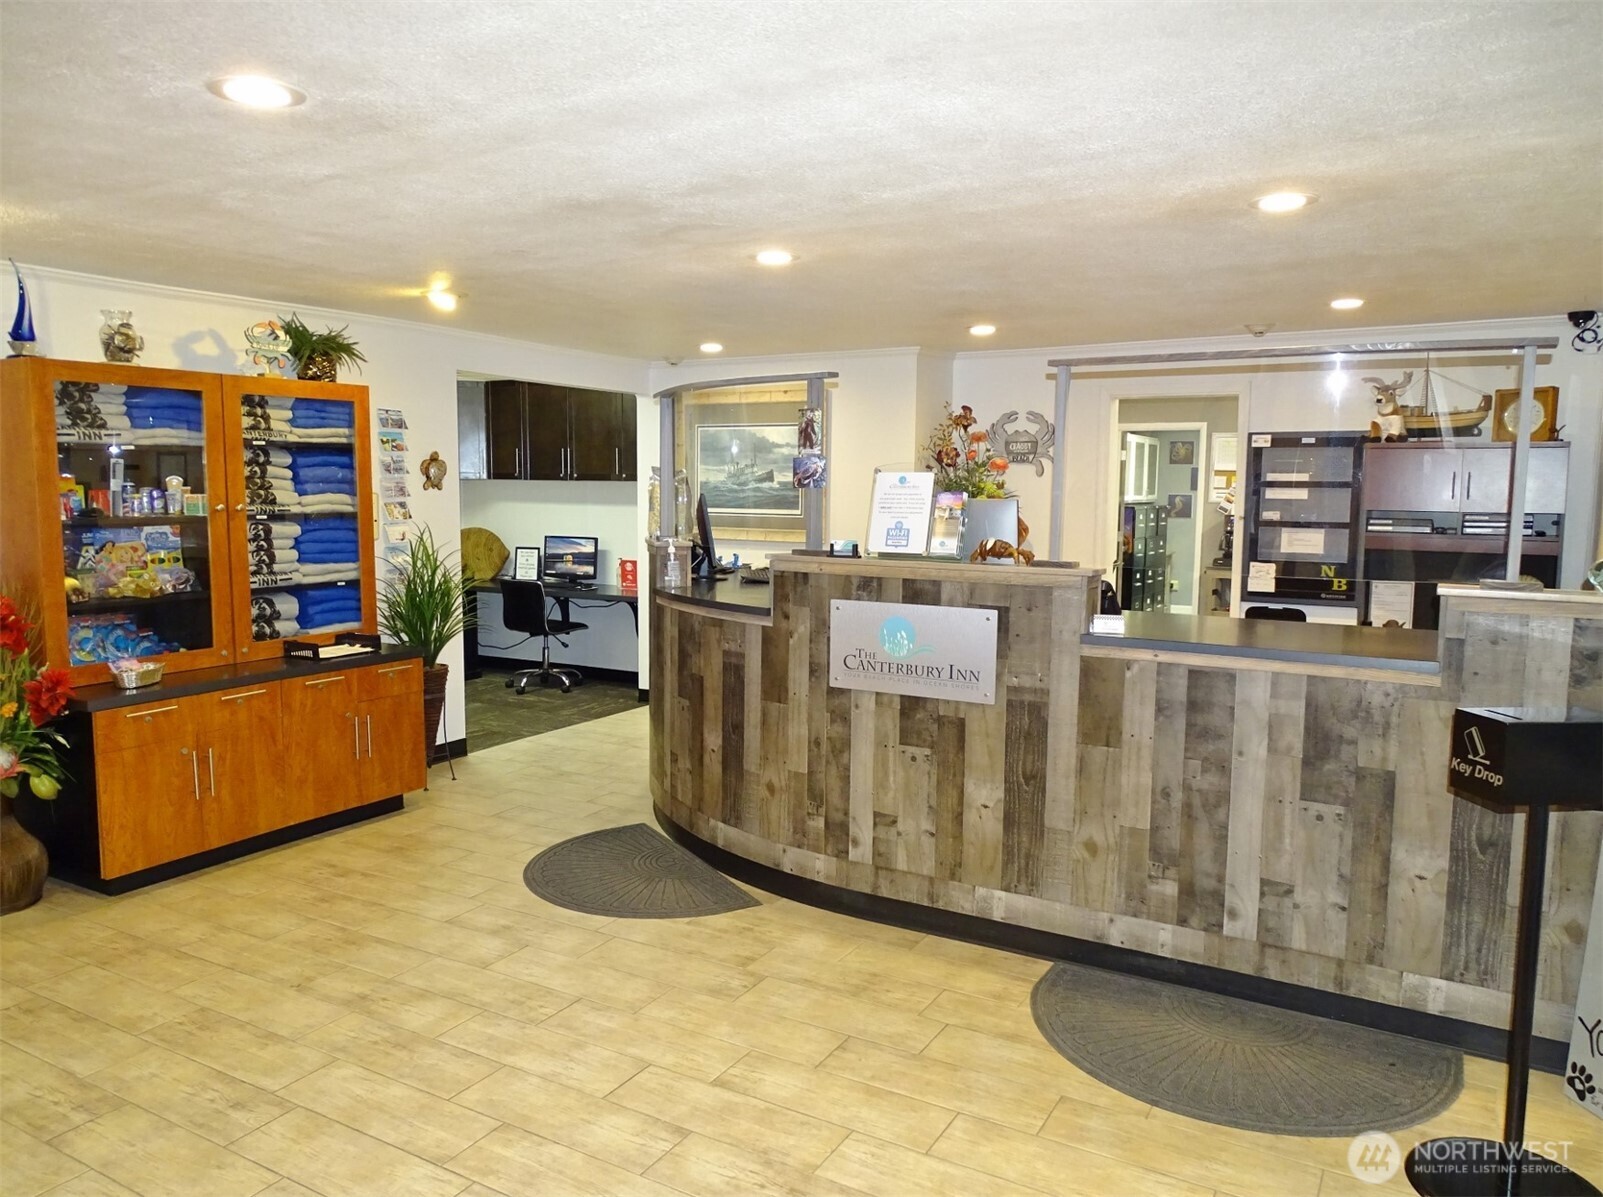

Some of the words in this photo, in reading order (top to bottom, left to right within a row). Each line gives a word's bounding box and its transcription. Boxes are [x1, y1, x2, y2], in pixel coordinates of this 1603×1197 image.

[76, 430, 103, 441] INN
[255, 506, 276, 515] INN
[1320, 565, 1336, 578] N
[258, 577, 278, 587] INN
[1331, 578, 1348, 591] B
[855, 648, 877, 660] THE
[843, 654, 944, 679] CANTERBURY
[948, 664, 981, 682] INN
[1451, 757, 1473, 777] Key
[1474, 765, 1503, 787] Drop
